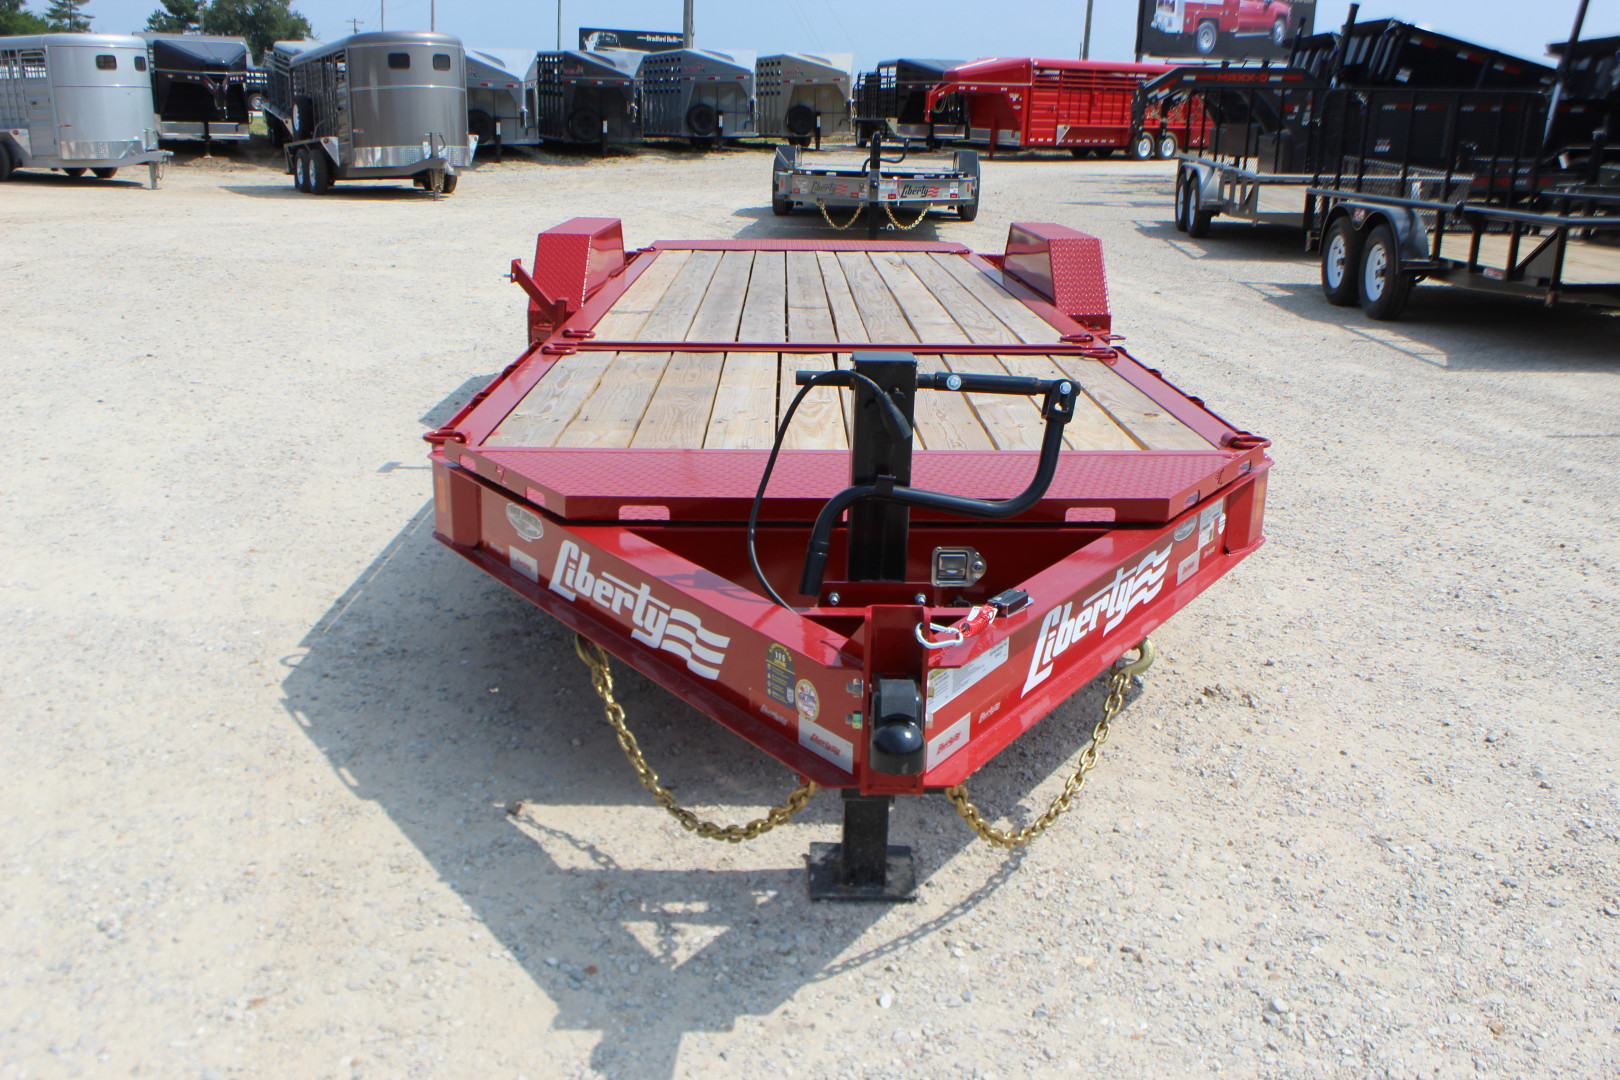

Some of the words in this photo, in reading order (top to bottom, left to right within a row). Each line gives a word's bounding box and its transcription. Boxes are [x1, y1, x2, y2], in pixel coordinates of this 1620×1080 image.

[810, 180, 837, 195] Liberty
[900, 184, 929, 198] Liberty
[548, 540, 671, 649] Liberty
[1020, 565, 1138, 699] Liberty
